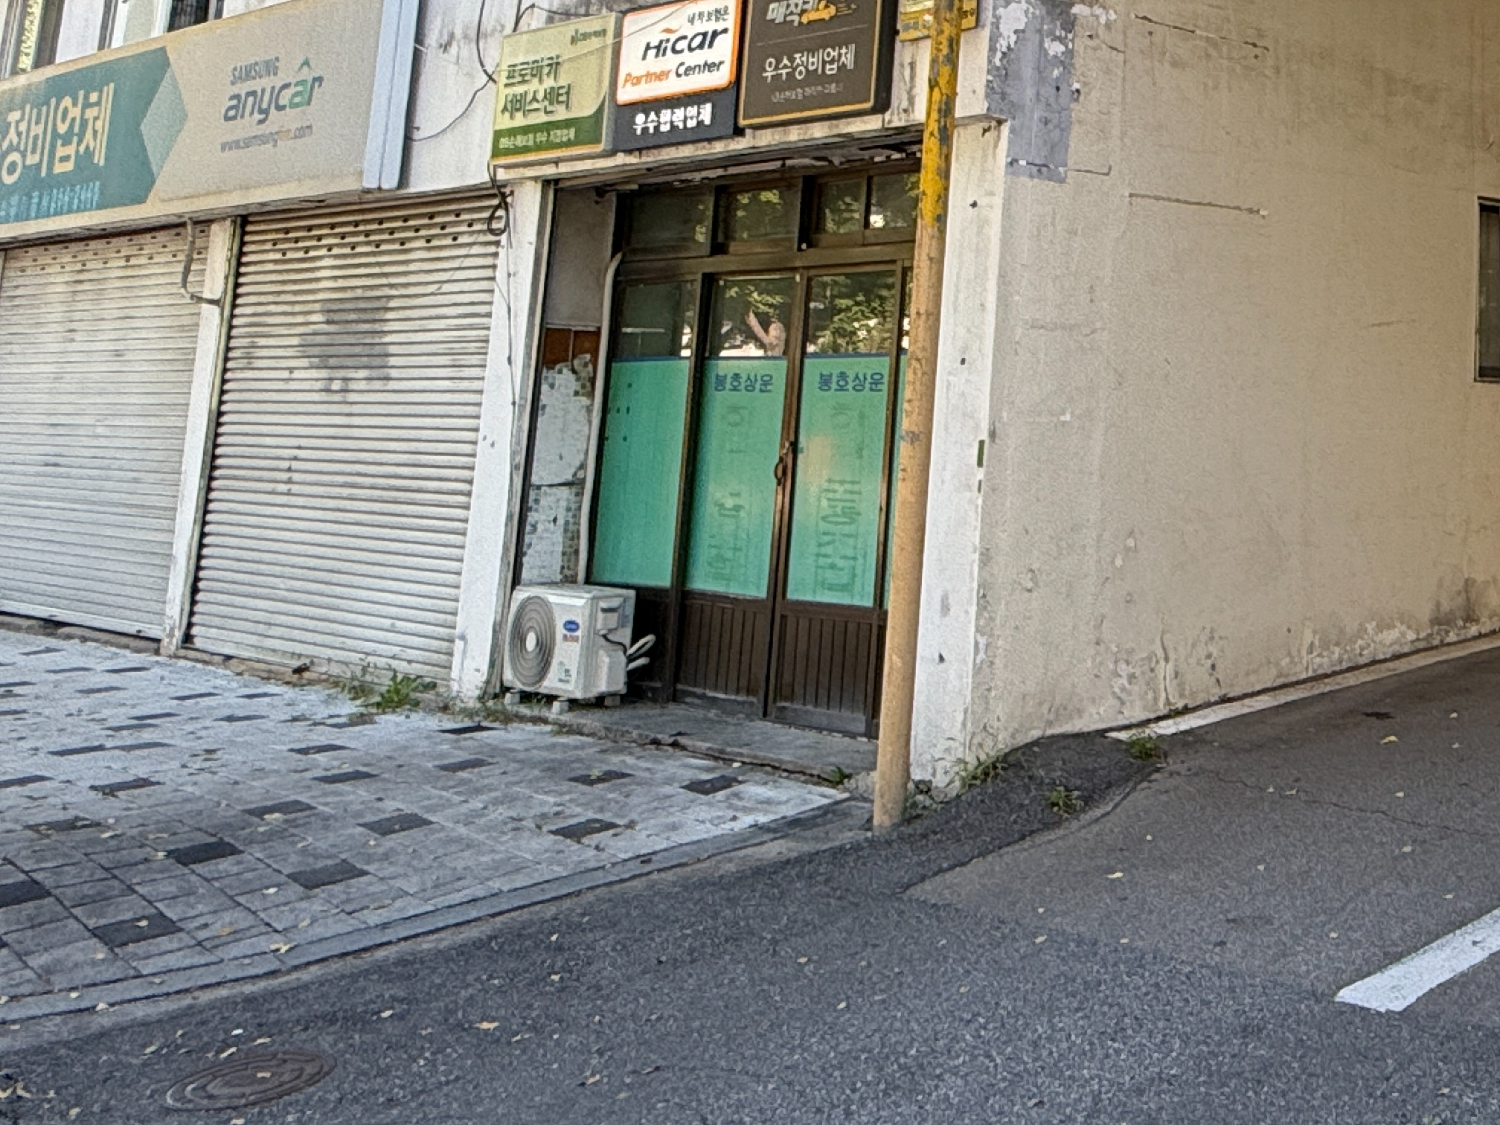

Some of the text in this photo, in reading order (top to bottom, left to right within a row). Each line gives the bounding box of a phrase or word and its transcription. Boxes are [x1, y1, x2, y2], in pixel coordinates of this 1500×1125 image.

[641, 27, 729, 61] Hicar
[220, 56, 280, 86] SAMSUNG
[504, 54, 562, 88] 프로미카
[621, 59, 726, 88] Partner Center
[762, 43, 856, 83] 우수정비업체
[223, 74, 325, 126] anycar
[500, 83, 572, 120] 서비스센터
[1, 81, 116, 186] 정비업체
[632, 101, 713, 136] 우수협력업체
[713, 373, 775, 393] 봉호상운
[817, 371, 886, 393] 봉호상운
